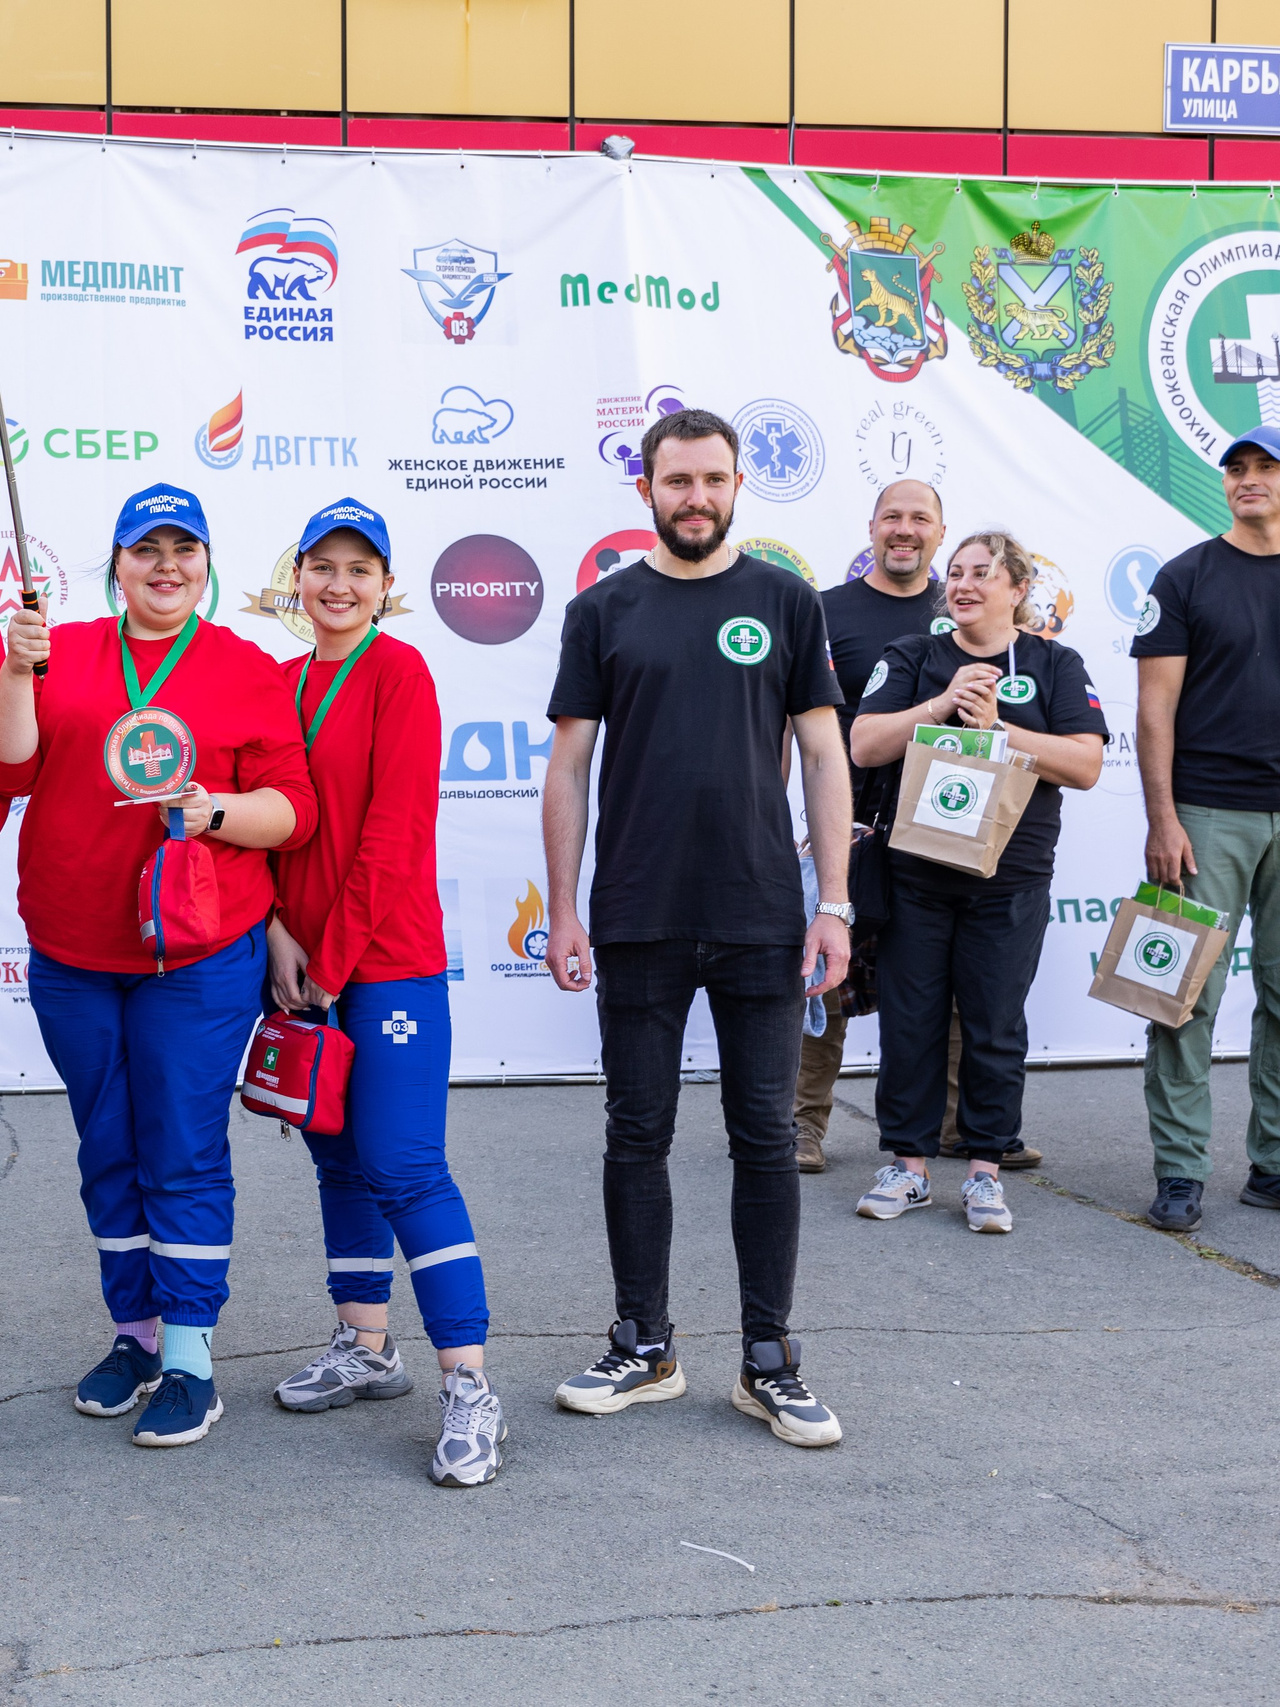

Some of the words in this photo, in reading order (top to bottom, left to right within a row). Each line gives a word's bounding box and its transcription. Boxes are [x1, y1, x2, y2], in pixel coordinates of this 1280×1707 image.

[1182, 98, 1238, 122] УЛИЦА
[41, 260, 184, 293] МЕДПЛАНТ
[40, 292, 126, 303] производственное
[129, 295, 186, 307] предприятие
[560, 272, 720, 312] MedMod
[244, 306, 333, 324] ЕДИНАЯ
[244, 324, 333, 342] РОССИЯ
[451, 319, 468, 337] 03
[1160, 288, 1217, 456] Тихоокеанская
[596, 396, 641, 404] ДВИЖЕНИЕ
[596, 406, 643, 416] МАТЕРИ
[597, 418, 645, 429] РОССИИ
[855, 400, 885, 440] real
[892, 401, 943, 446] green
[44, 428, 159, 461] СБЕР
[252, 434, 359, 471] ДВГГТК
[387, 459, 468, 471] ЖЕНСКОЕ
[473, 457, 565, 472] ДВИЖЕНИЕ
[406, 474, 474, 491] ЕДИНОЙ
[479, 477, 548, 489] РОССИИ
[135, 494, 190, 511] ПРИМОРСКИЙ
[149, 503, 177, 514] ПУЛЬС
[321, 506, 374, 522] ПРИМОРСКИЙ
[334, 513, 360, 522] ПУЛЬС
[1, 530, 37, 543] ЦЕТР
[37, 541, 59, 564] МОО
[755, 540, 789, 555] России
[791, 554, 802, 566] по
[435, 581, 539, 597] PRIORITY
[439, 787, 539, 800] ДАВЫДОВСКИЙ
[392, 1022, 408, 1032] 03
